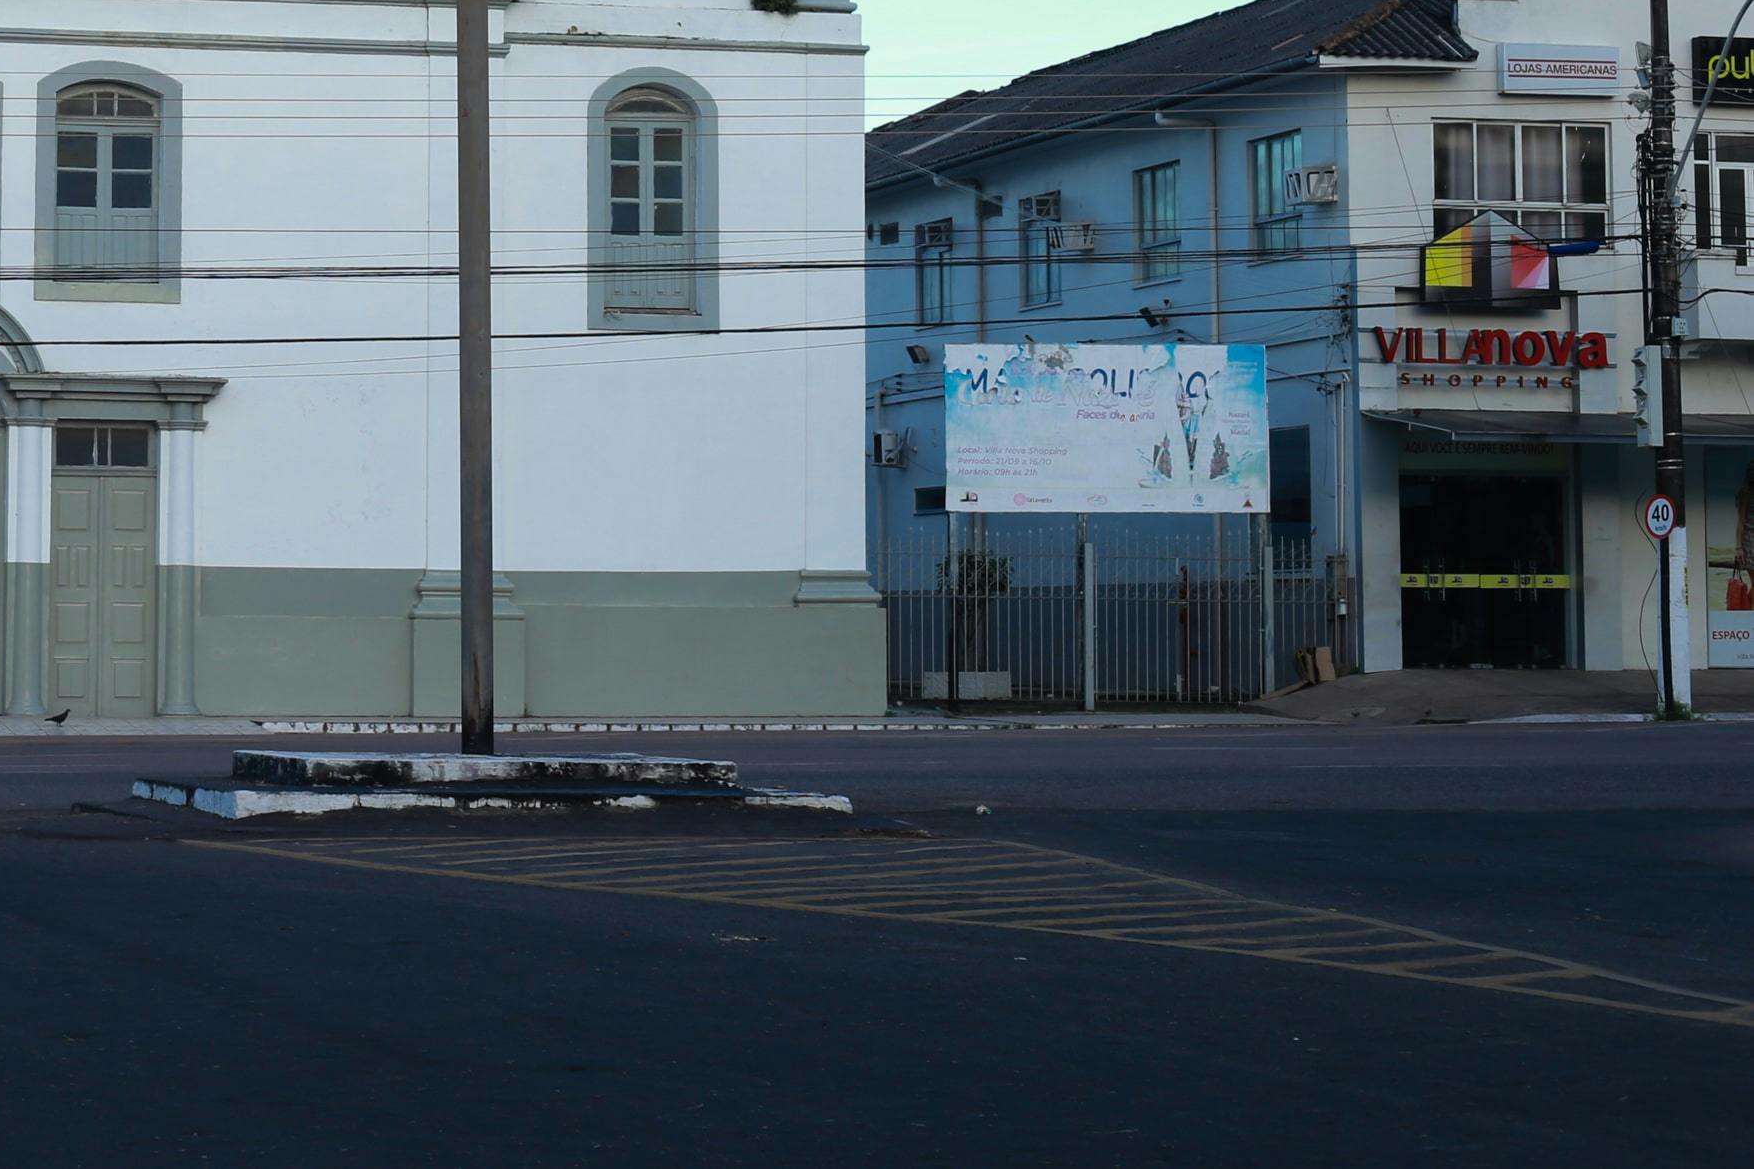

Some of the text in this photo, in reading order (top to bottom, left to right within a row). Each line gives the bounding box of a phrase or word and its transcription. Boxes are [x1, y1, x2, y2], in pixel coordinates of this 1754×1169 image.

[1508, 62, 1618, 76] LOJAS AMERICANAS
[1400, 372, 1574, 389] SHOPPING
[1076, 409, 1107, 420] Faces
[957, 446, 982, 454] Local:
[1029, 445, 1069, 456] Shopping
[1462, 442, 1497, 455] SEMPRE
[1652, 503, 1669, 522] 40
[1712, 630, 1750, 642] ESPAÇO
